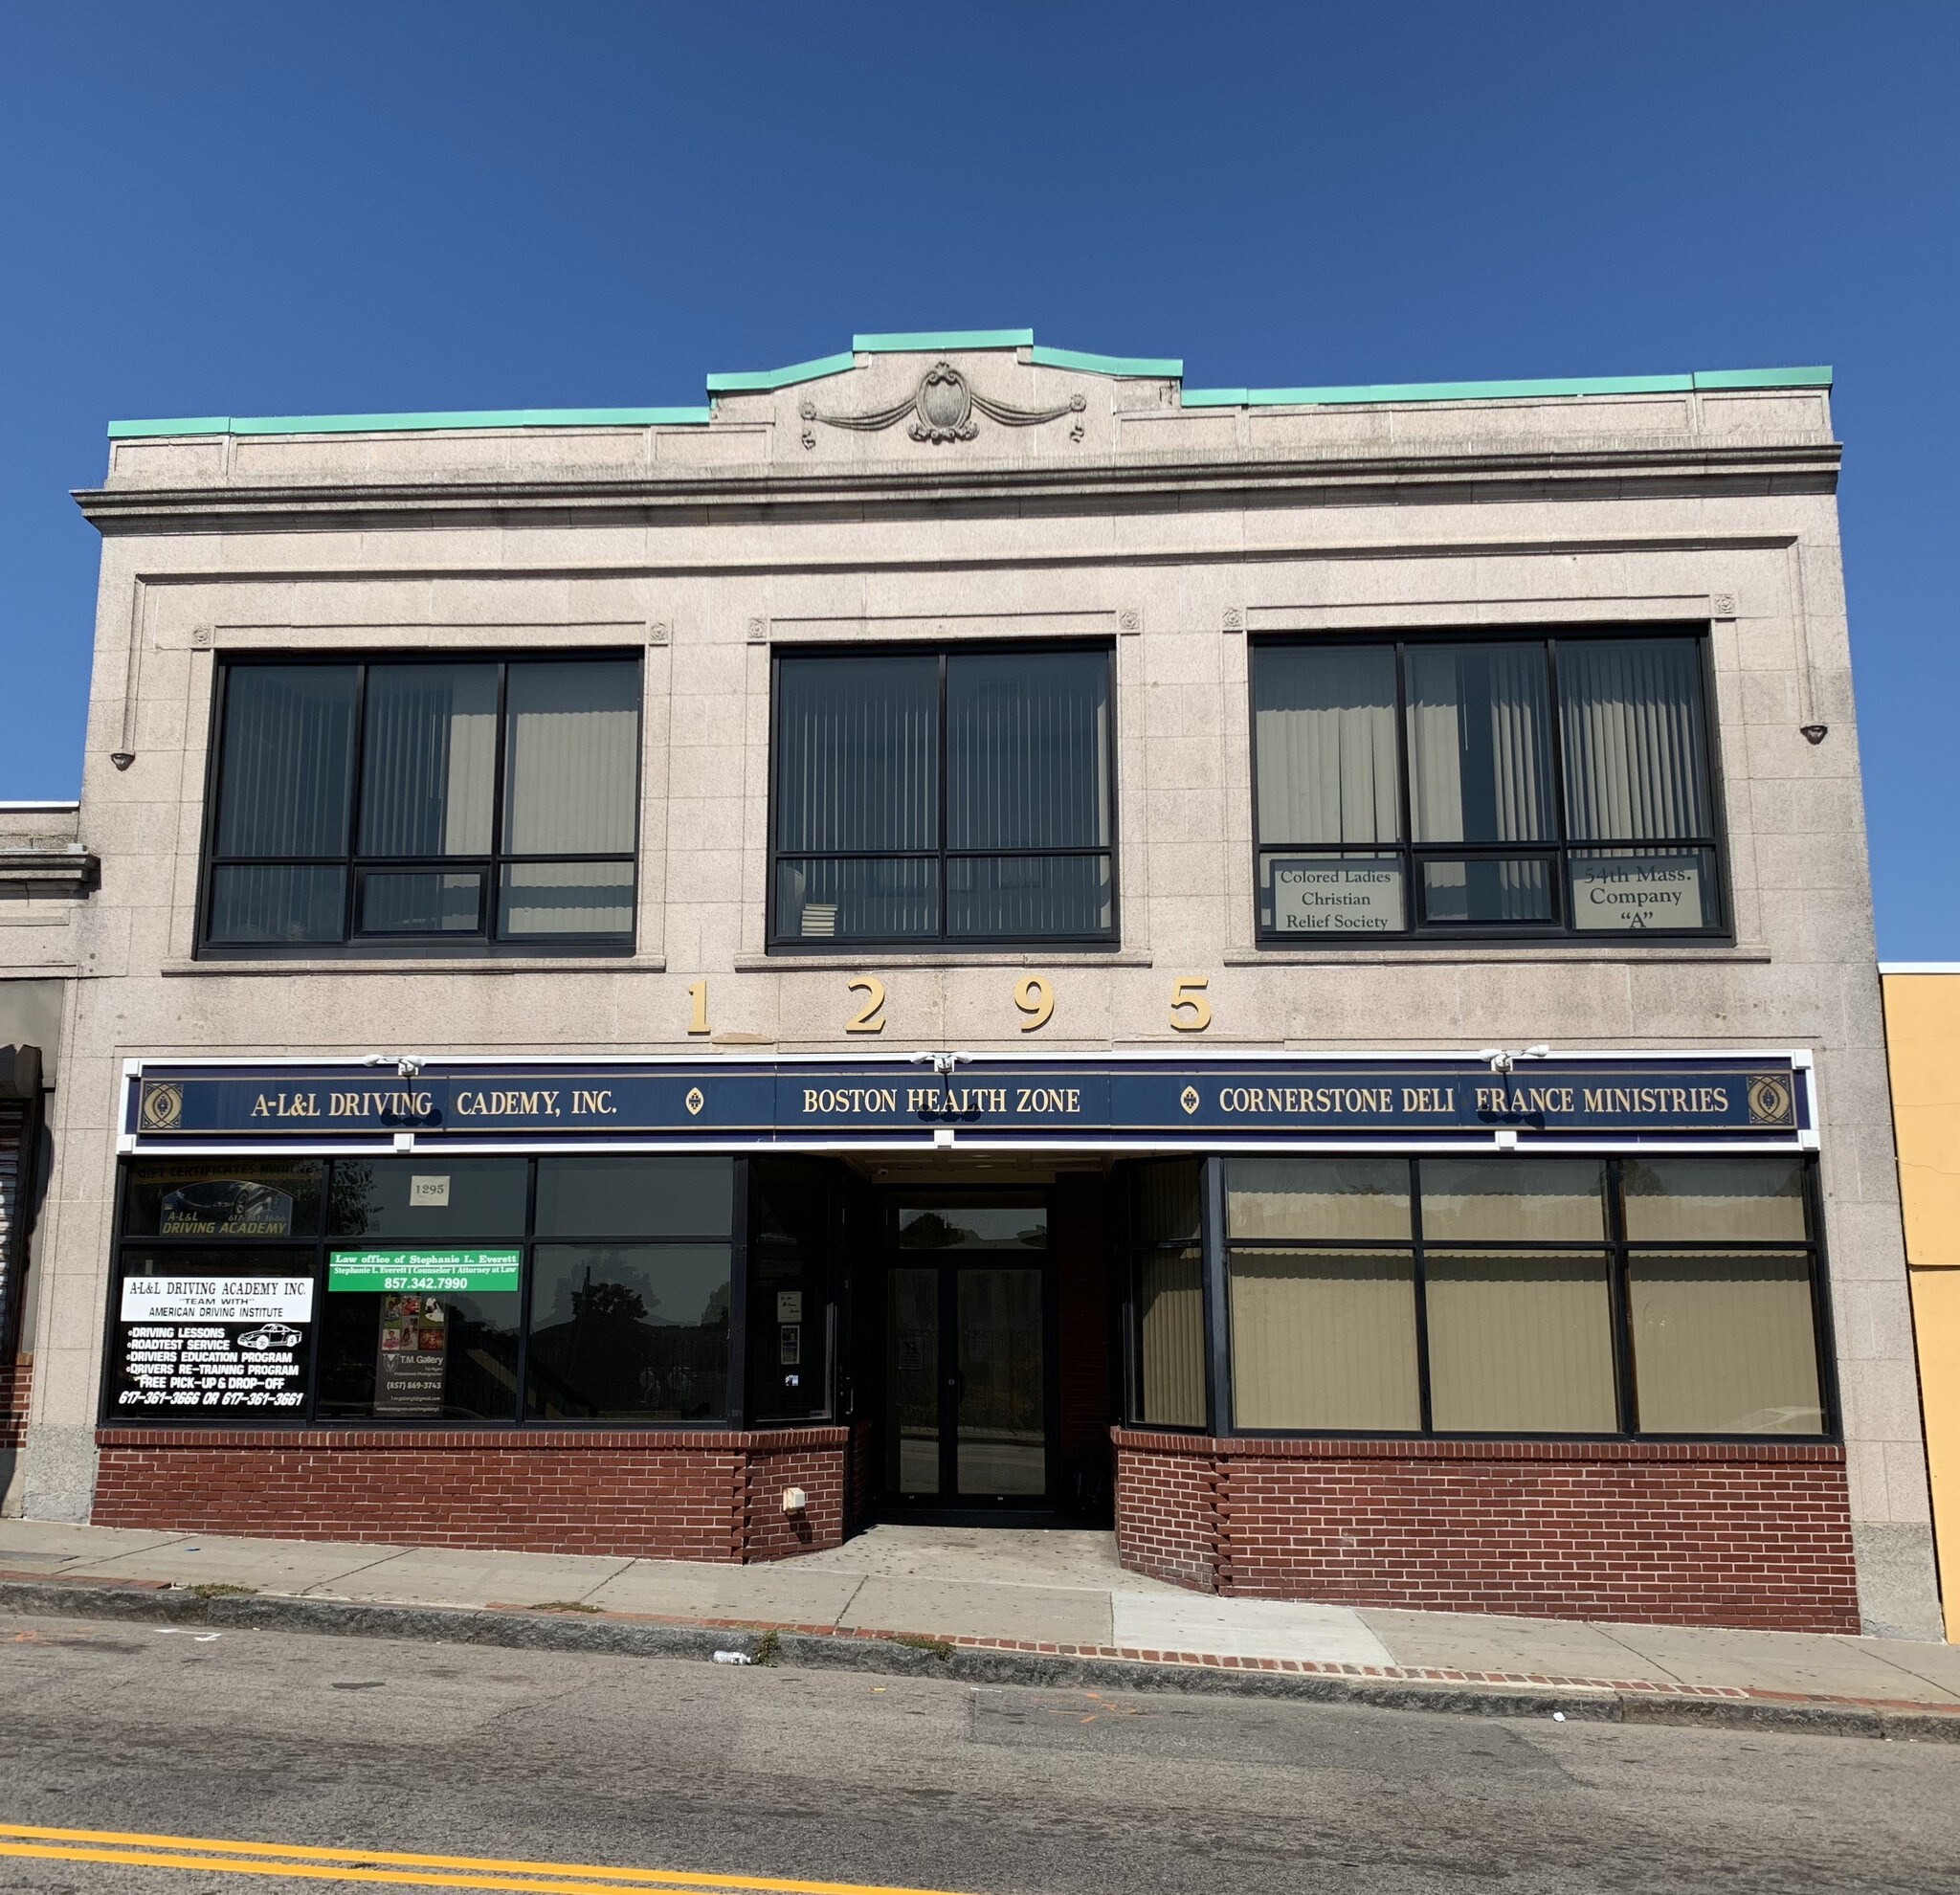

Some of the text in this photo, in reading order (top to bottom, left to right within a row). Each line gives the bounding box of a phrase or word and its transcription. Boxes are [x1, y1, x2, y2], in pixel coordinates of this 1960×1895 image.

[1281, 869, 1392, 883] Colored Ladies
[1584, 864, 1691, 883] 54th Mass.
[1302, 891, 1371, 905] Christian
[1590, 887, 1682, 907] Company
[1286, 913, 1389, 931] Relief Society
[250, 1090, 617, 1118] A-L&L DRIVING CADEMY, INC.
[802, 1088, 1081, 1113] BOSTON HEALTH ZONE
[1219, 1087, 1393, 1113] CORNERSTONE
[1582, 1087, 1729, 1113] MINISTRIES
[414, 1184, 445, 1195] 1295
[167, 1211, 199, 1221] A-L&L
[162, 1221, 287, 1235] DRIVING ACADEMY
[335, 1254, 517, 1265] Law office of Stephanie L. Everett
[333, 1266, 371, 1276] Stephanie
[457, 1266, 491, 1275] Attorney
[129, 1282, 161, 1295] A-L&L
[167, 1282, 216, 1295] DRIVING
[221, 1282, 279, 1295] ACADEMY
[384, 1277, 468, 1289] 857.342.7990
[148, 1306, 283, 1318] AMERICAN DRIVING INSTITUTE
[132, 1326, 226, 1339] DRIVING LESSONS
[131, 1339, 231, 1350] ROADTEST SERVICE
[180, 1351, 238, 1363] EDUCATION
[241, 1351, 293, 1363] PROGRAM
[129, 1363, 175, 1374] DRIVERS
[248, 1365, 300, 1376] PROGRAM
[139, 1376, 285, 1390] FREE PICK-UP & DROP-OFF
[386, 1381, 406, 1391] (857)
[118, 1391, 304, 1406] 617-361-3666 OR 617-361-3661
